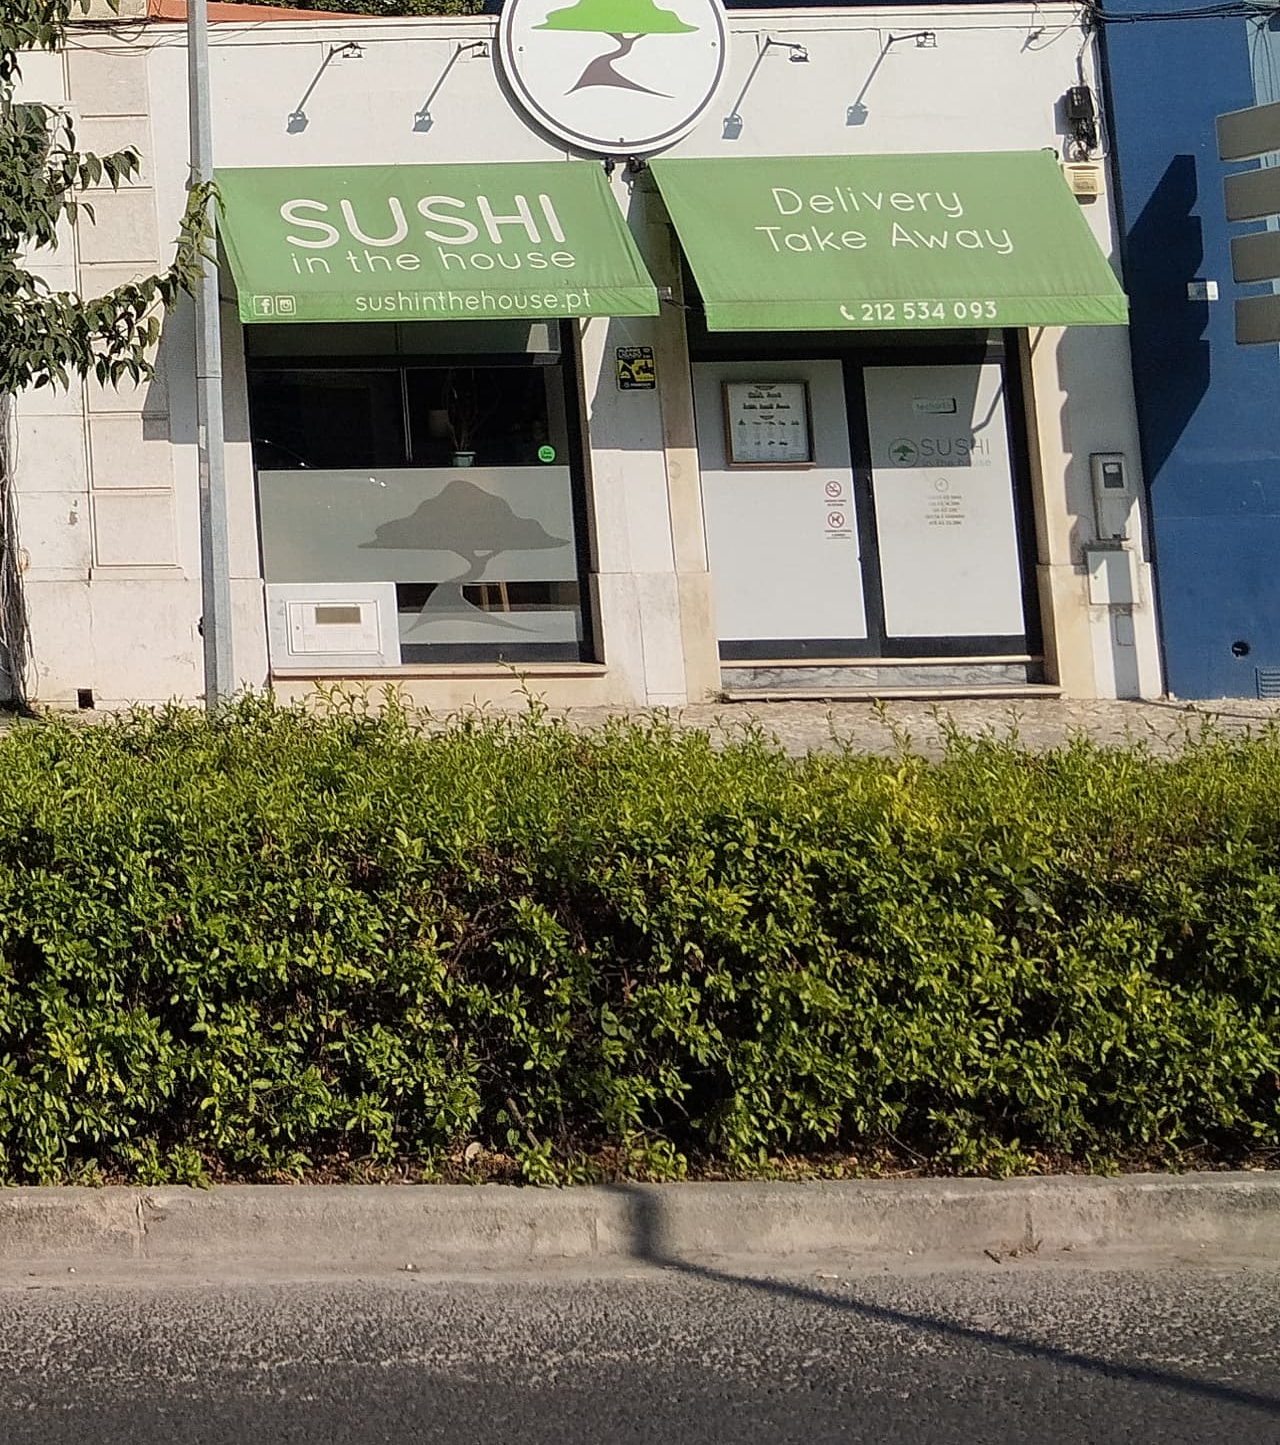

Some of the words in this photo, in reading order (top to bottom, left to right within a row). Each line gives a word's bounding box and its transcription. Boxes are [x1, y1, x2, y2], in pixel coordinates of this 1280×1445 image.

[771, 186, 964, 218] Delivery
[279, 193, 567, 249] SUSHI
[755, 225, 867, 254] Take
[891, 221, 1014, 255] Away
[290, 252, 331, 275] in
[346, 249, 421, 274] the
[438, 246, 576, 271] house
[355, 288, 592, 313] sushinthehouse.pt
[860, 304, 896, 321] 212
[903, 303, 946, 321] 534
[953, 301, 998, 320] 093
[921, 438, 990, 456] SUSHI
